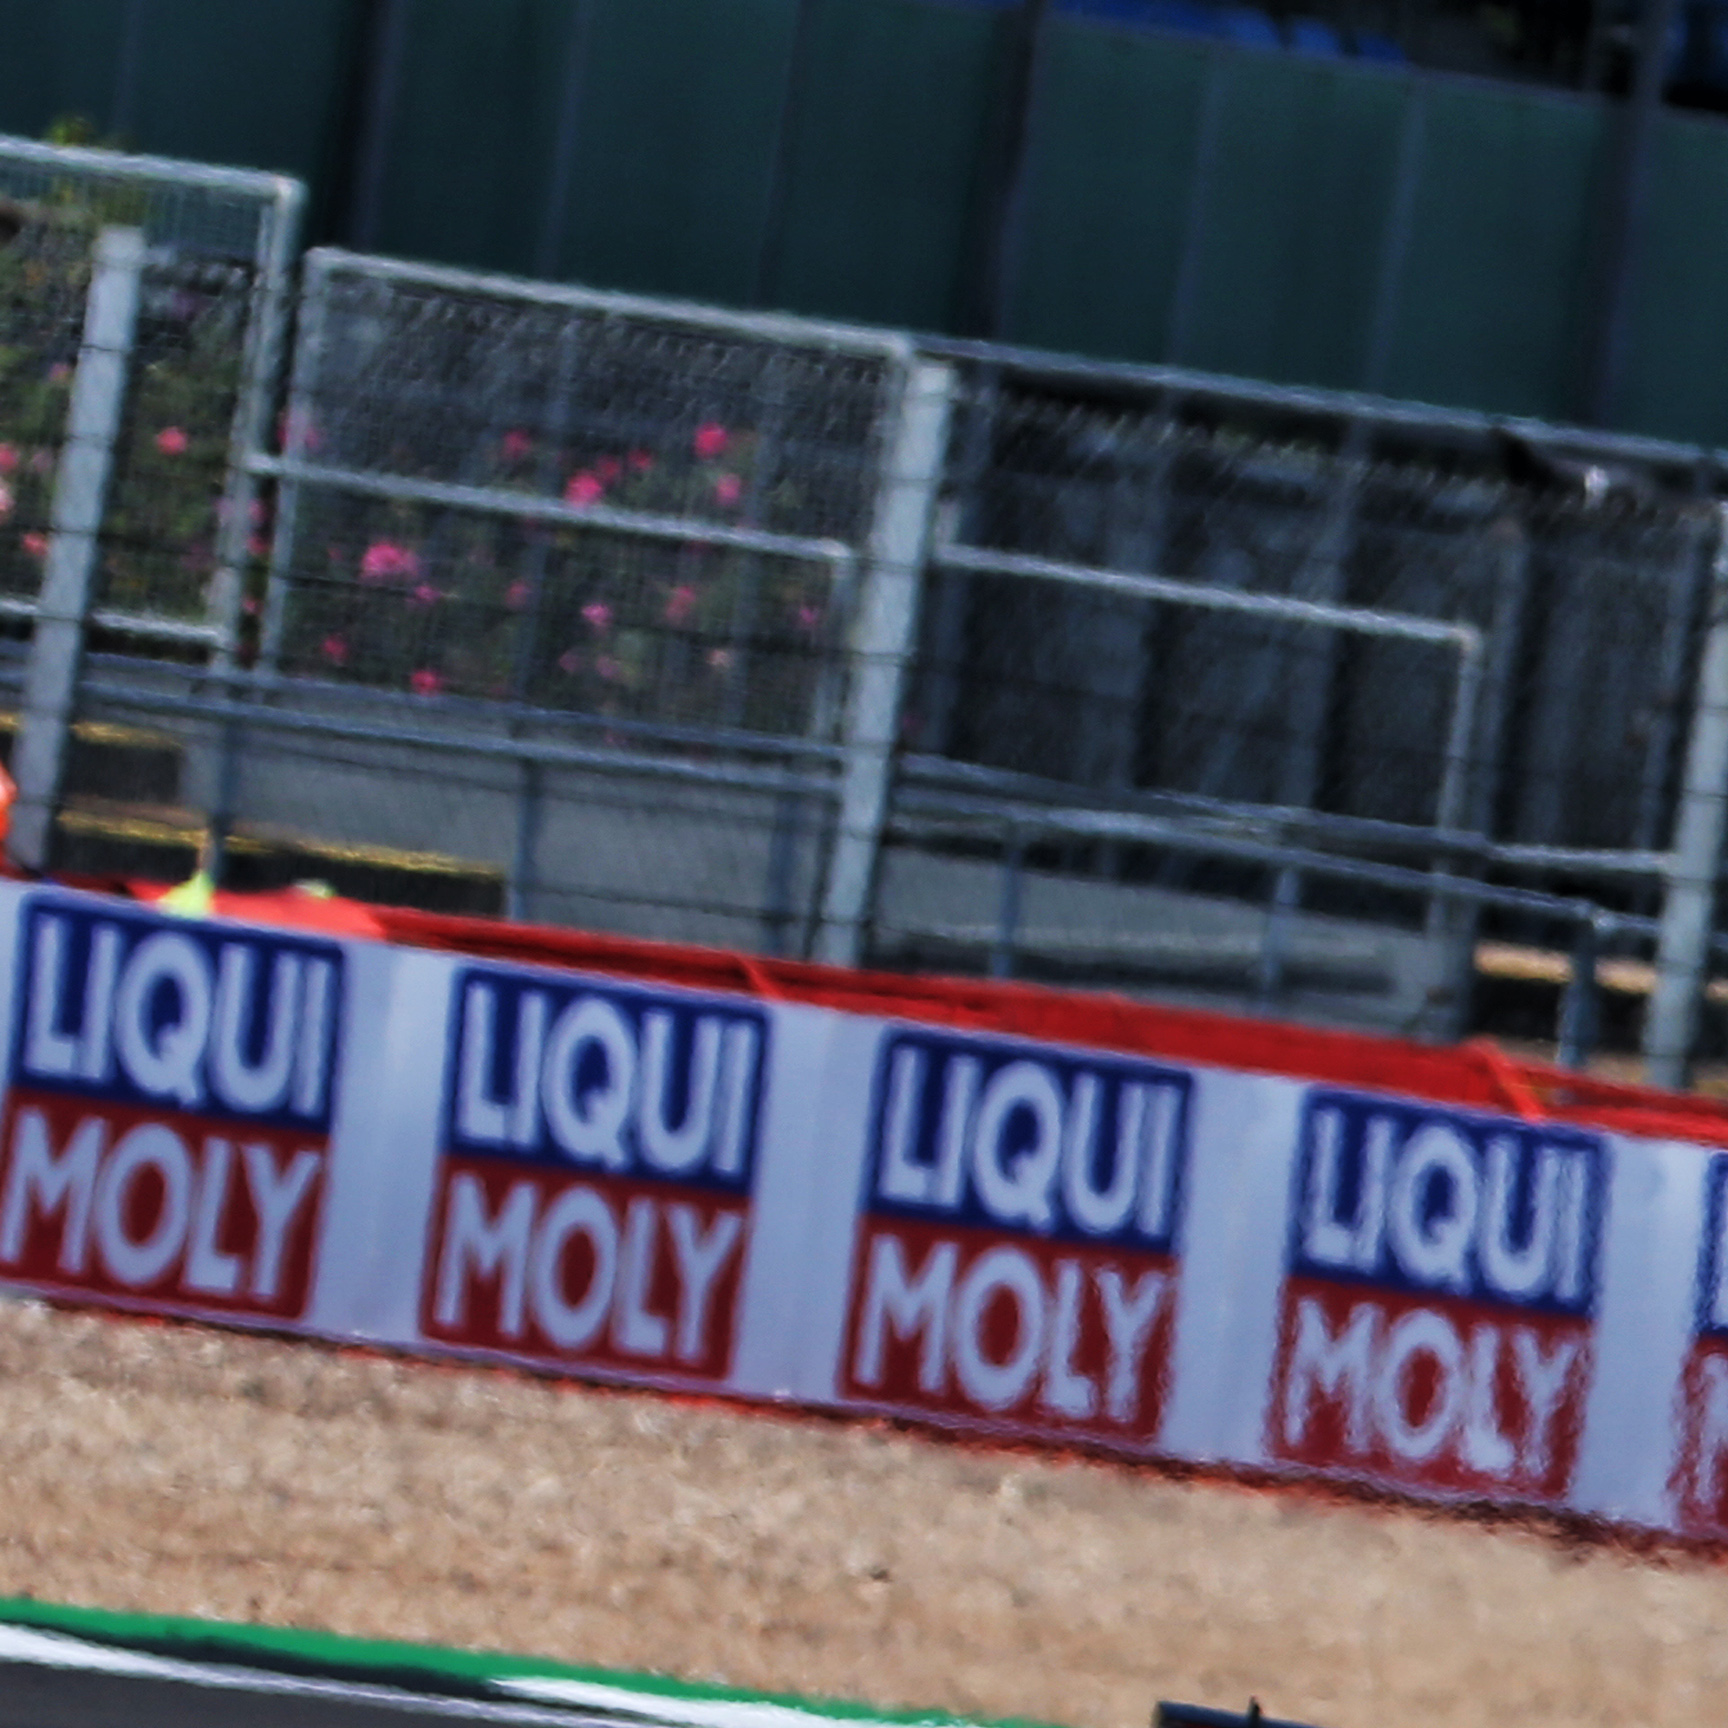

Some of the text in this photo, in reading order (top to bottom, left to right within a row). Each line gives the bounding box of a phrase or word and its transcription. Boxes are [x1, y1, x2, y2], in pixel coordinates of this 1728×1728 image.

[25, 916, 334, 1118] LIQUI
[456, 979, 762, 1177] LIQUI
[2, 1106, 321, 1299] MOLY
[877, 1043, 1182, 1240] LIQUI
[1303, 1106, 1593, 1304] LIQUI
[434, 1173, 743, 1364] MOLY
[854, 1235, 1170, 1426] MOLY
[1285, 1296, 1582, 1479] MOLY
